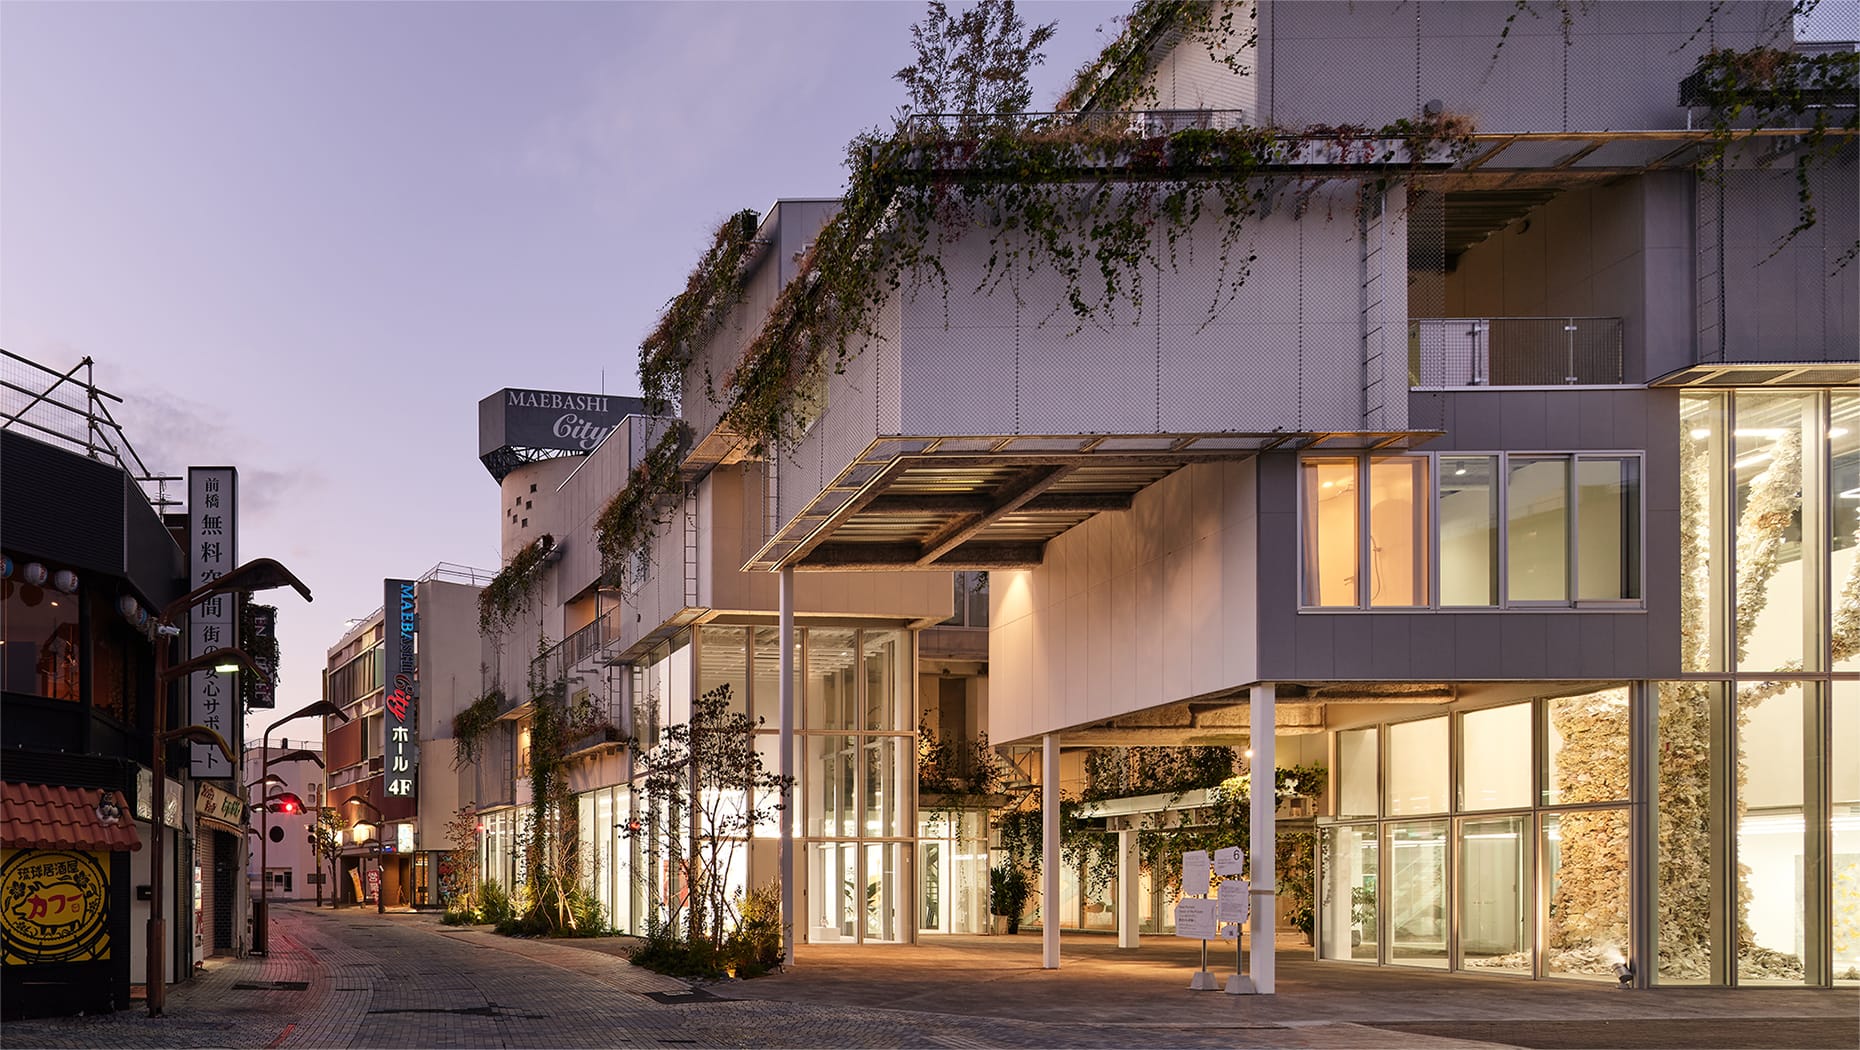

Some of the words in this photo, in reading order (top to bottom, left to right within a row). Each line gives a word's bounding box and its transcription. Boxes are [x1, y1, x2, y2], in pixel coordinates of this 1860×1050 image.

[508, 391, 609, 413] MAEBASHI
[552, 413, 609, 450] City
[204, 477, 220, 509] 前橋
[400, 583, 415, 673] MAEBASHI
[386, 674, 415, 723] City
[392, 726, 409, 772] ホール
[388, 779, 413, 795] 4F
[1233, 849, 1240, 861] 6
[17, 860, 79, 881] 琉球居酒屋
[27, 893, 83, 919] カフー
